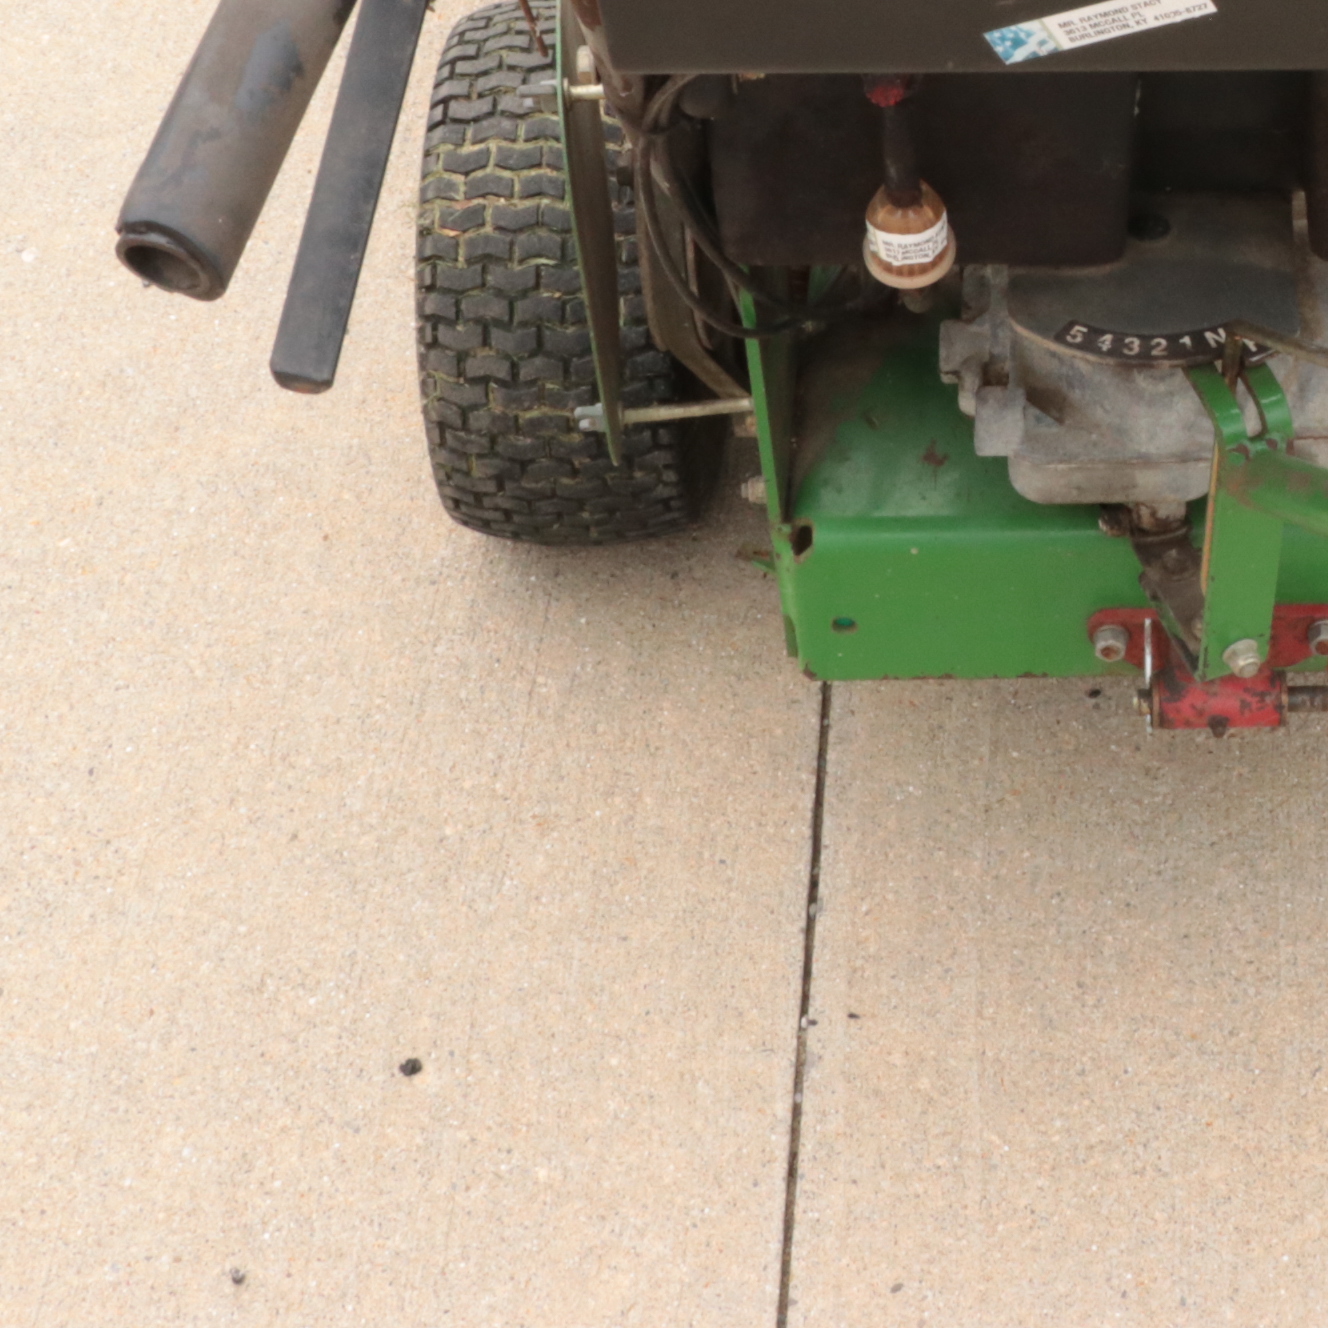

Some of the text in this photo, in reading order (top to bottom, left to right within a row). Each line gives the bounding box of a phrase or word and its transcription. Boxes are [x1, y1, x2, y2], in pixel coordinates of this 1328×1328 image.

[1079, 6, 1129, 24] RAYMOND
[1134, 17, 1149, 27] KY
[1065, 325, 1088, 344] 5
[1097, 333, 1114, 352] 4
[1122, 337, 1141, 355] 3
[1150, 338, 1168, 356] 2
[1179, 335, 1193, 352] 1
[1204, 327, 1227, 348] N
